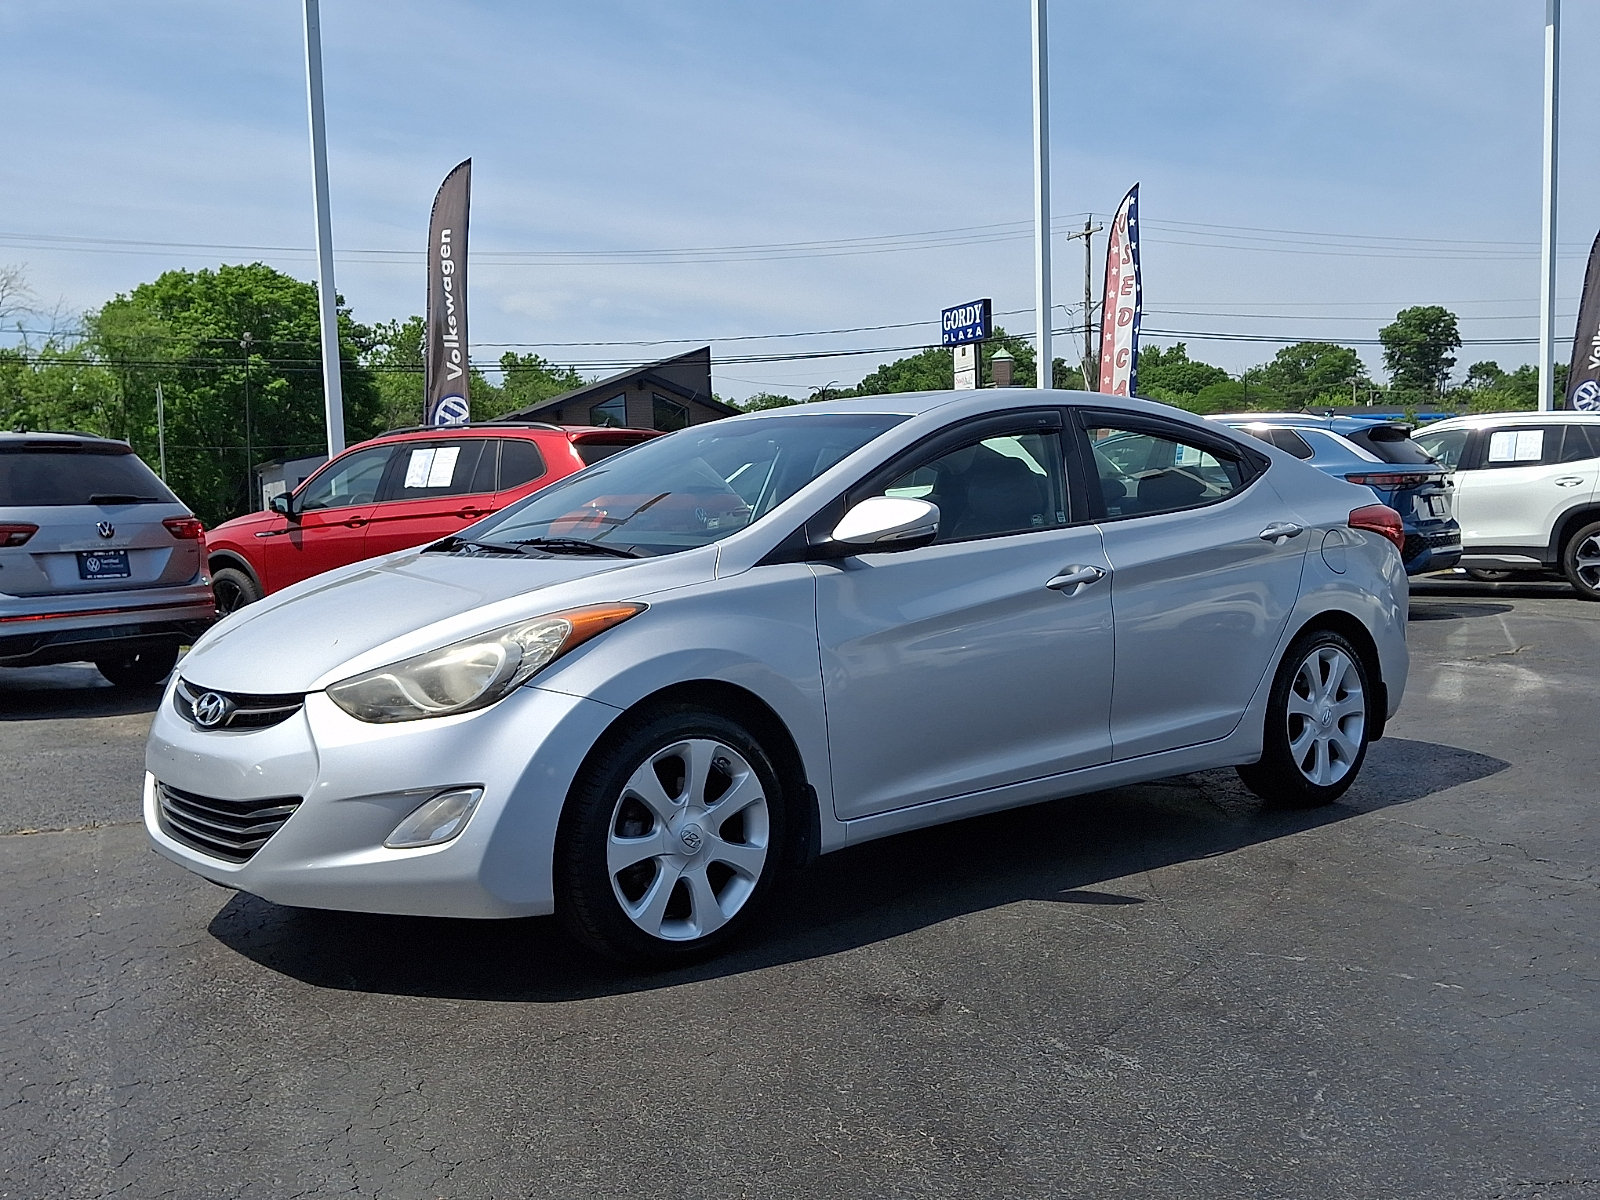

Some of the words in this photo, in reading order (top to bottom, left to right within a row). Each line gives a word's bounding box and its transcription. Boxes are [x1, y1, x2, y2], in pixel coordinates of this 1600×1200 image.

[1117, 212, 1135, 327] USED
[440, 228, 463, 381] Volkswagen
[943, 303, 983, 331] GORDY
[943, 326, 983, 344] PLAZA
[1114, 347, 1130, 397] CA
